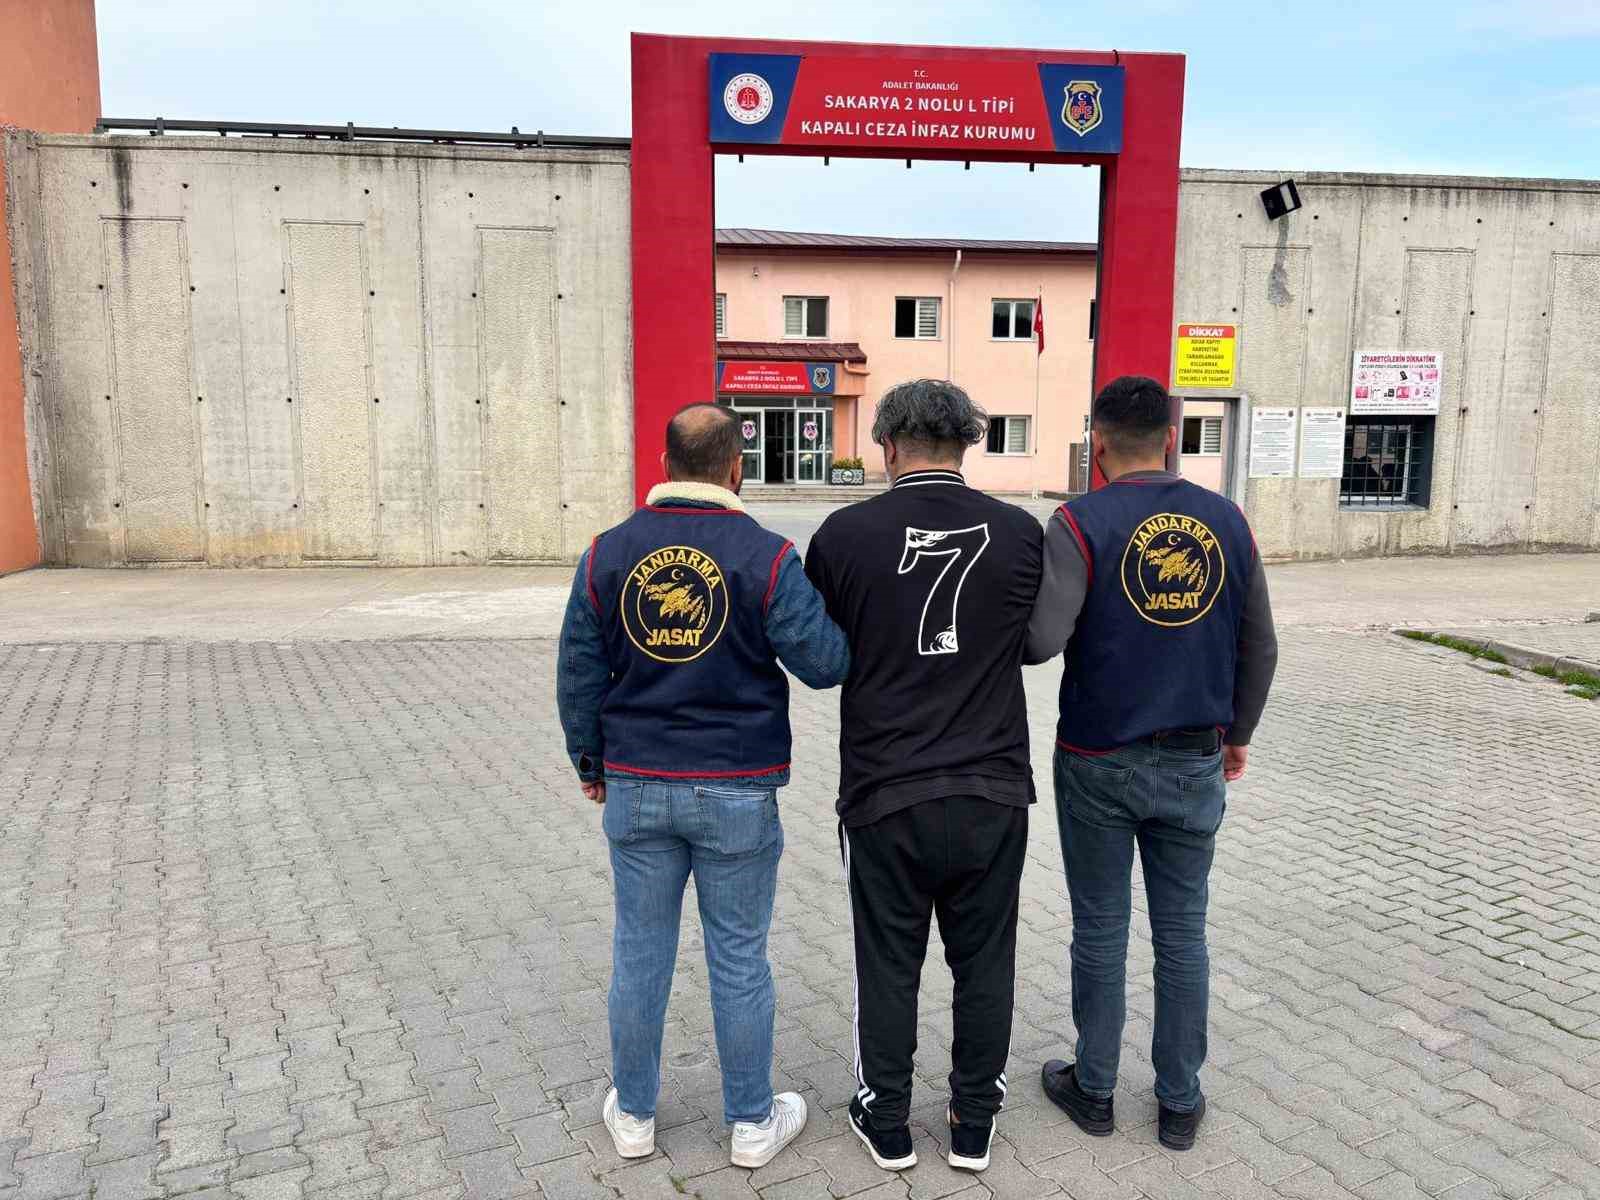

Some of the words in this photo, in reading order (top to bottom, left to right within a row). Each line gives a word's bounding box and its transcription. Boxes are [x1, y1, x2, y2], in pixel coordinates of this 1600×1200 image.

[913, 70, 928, 78] T.C.
[882, 81, 913, 89] ADALET
[915, 81, 959, 91] BAKANLIĞI
[824, 95, 900, 110] SAKARYA
[904, 97, 913, 111] 2
[918, 98, 963, 112] NOLU
[968, 99, 977, 112] L
[982, 96, 1014, 113] TİPİ
[801, 120, 860, 136] KAPALI
[865, 122, 907, 137] CEZA
[911, 120, 960, 138] İNFAZ
[964, 125, 1035, 140] KURUMU
[1188, 327, 1225, 337] DİKKAT
[1134, 517, 1216, 552] JANDARMA
[633, 550, 721, 590] JANDARMA
[898, 523, 990, 655] 7
[1145, 591, 1202, 610] JASAT
[645, 628, 704, 647] JASAT
